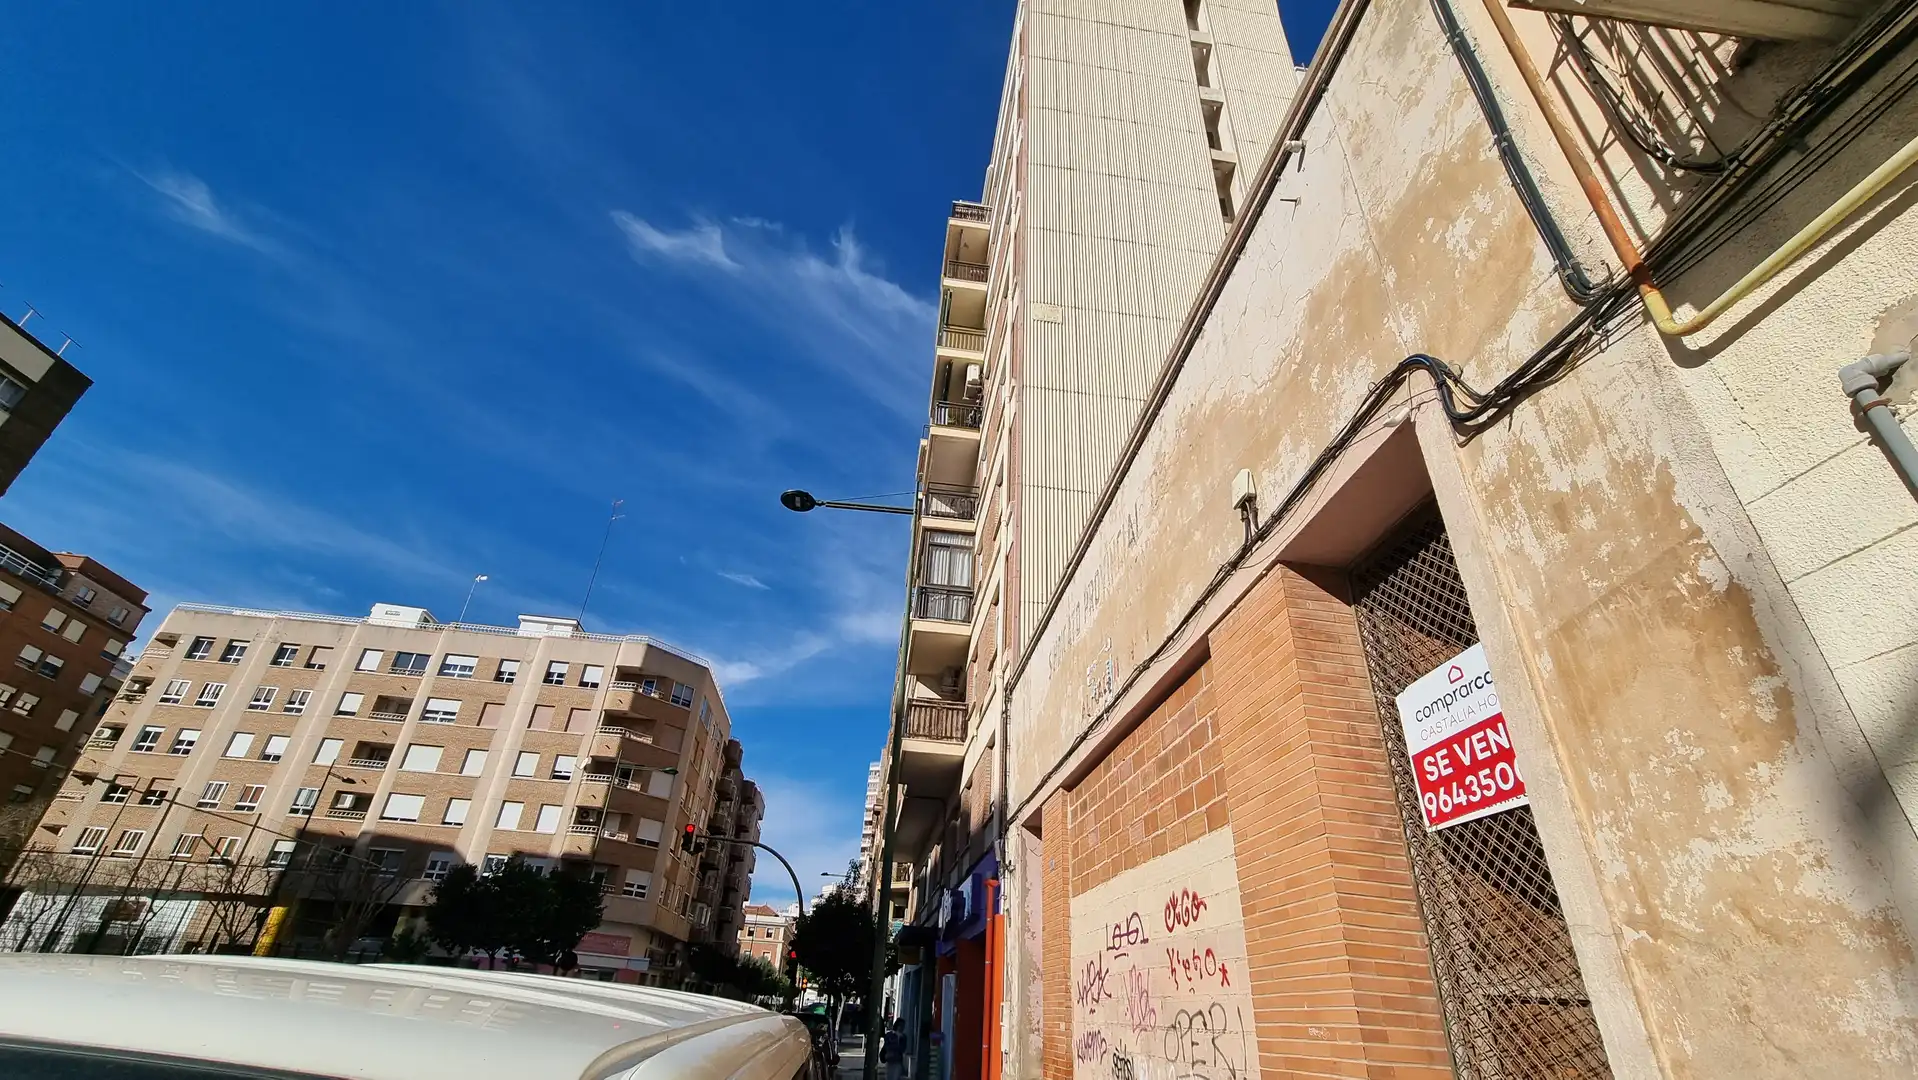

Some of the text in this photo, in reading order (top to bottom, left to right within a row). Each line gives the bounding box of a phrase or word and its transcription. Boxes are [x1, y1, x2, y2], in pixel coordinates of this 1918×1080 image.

[1420, 693, 1498, 741] CASTALIA HO
[1423, 722, 1511, 782] SE VEN
